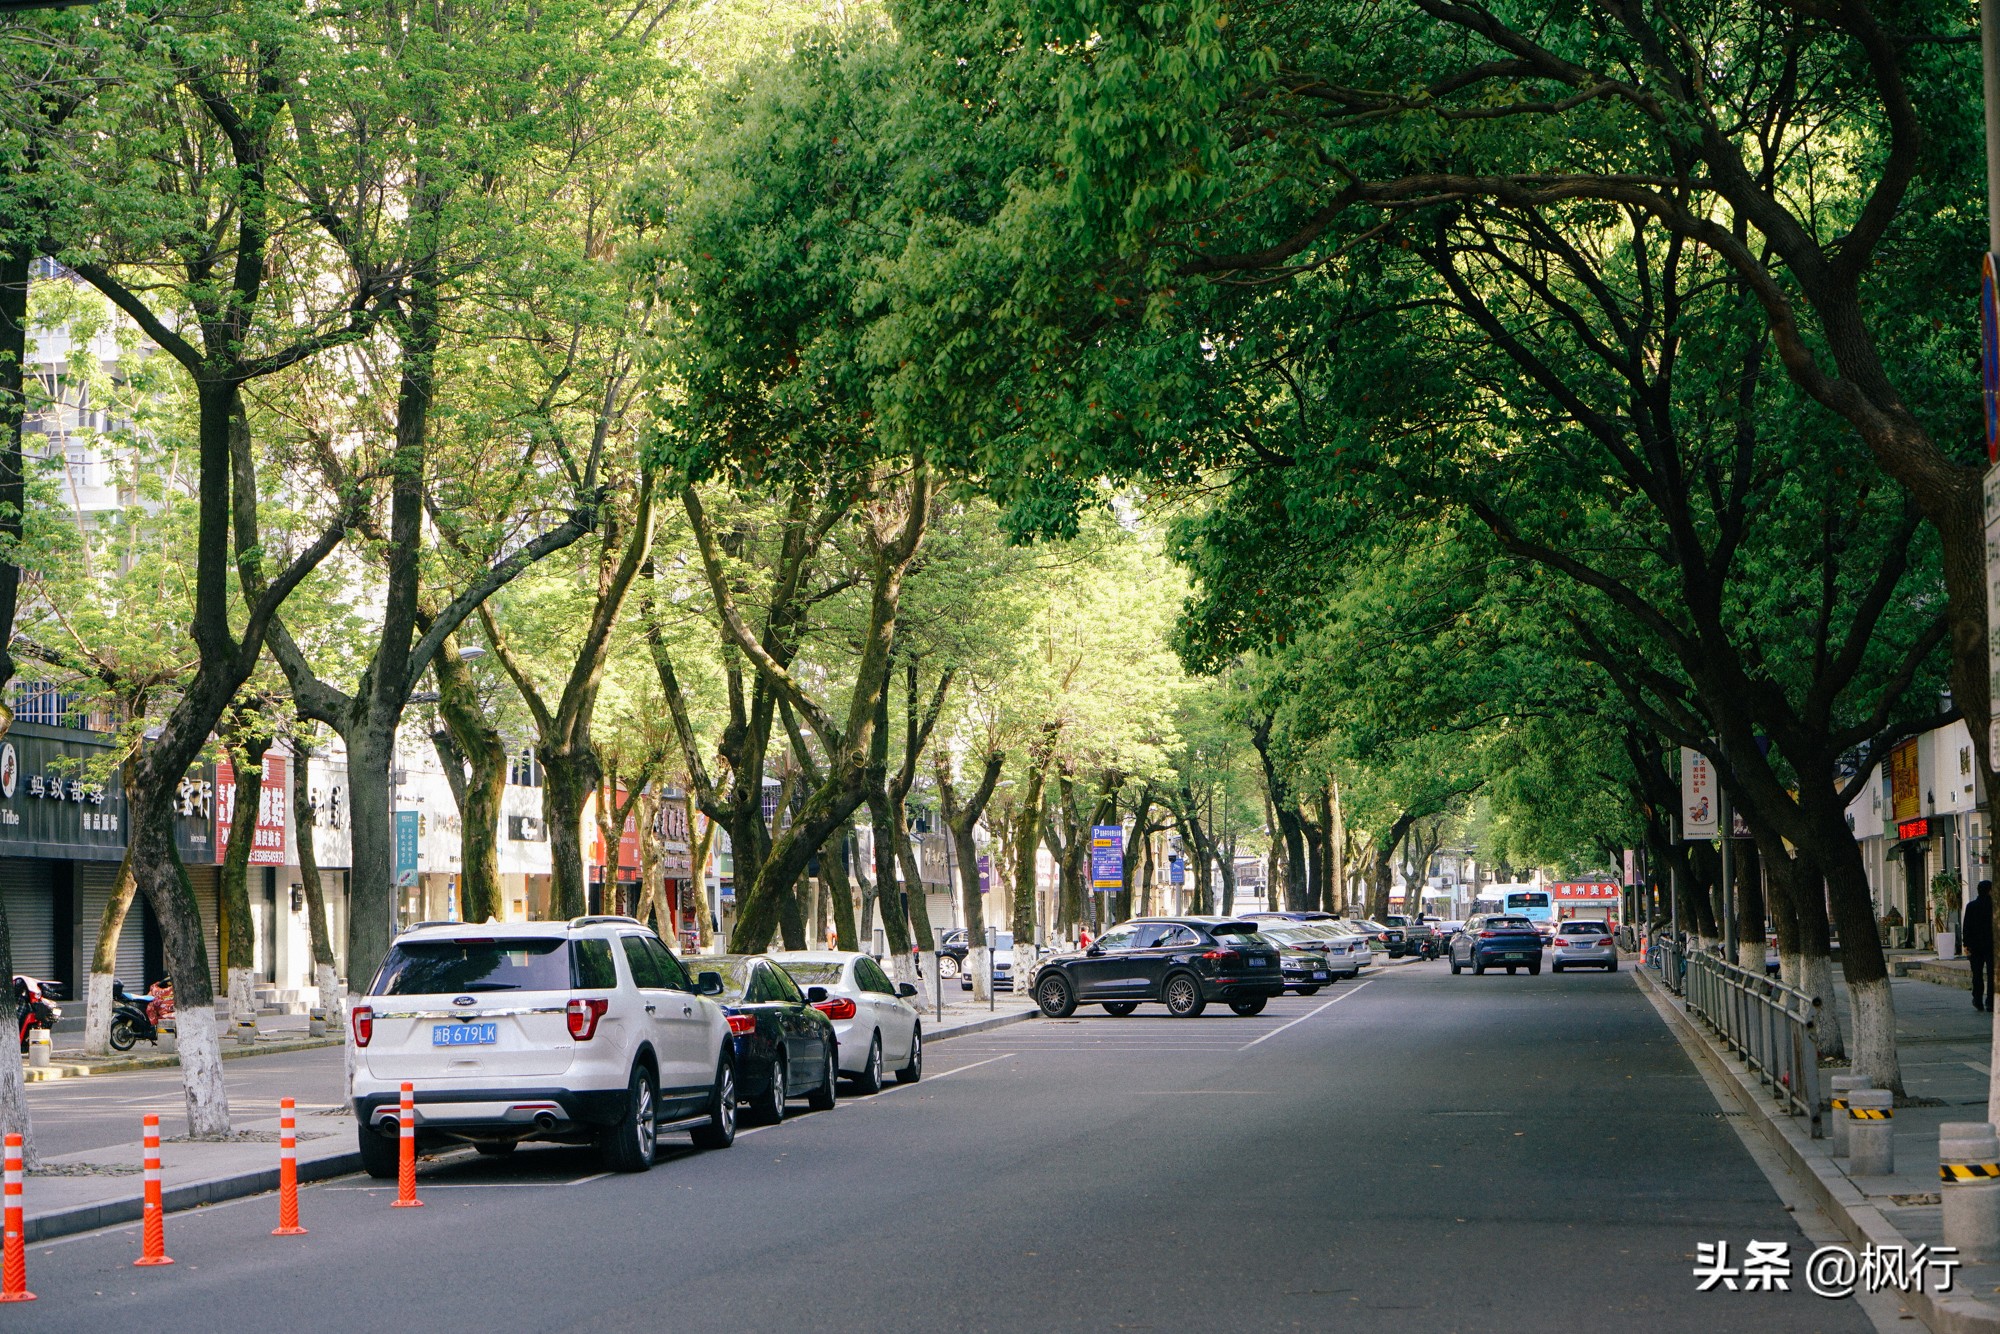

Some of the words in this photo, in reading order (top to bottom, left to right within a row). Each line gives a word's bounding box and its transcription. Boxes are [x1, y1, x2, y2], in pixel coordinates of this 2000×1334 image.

[30, 775, 105, 804] 蚂蚁部落
[83, 812, 118, 831] 精品服饰
[1093, 828, 1100, 839] P
[1561, 884, 1613, 896] 嵊州美食
